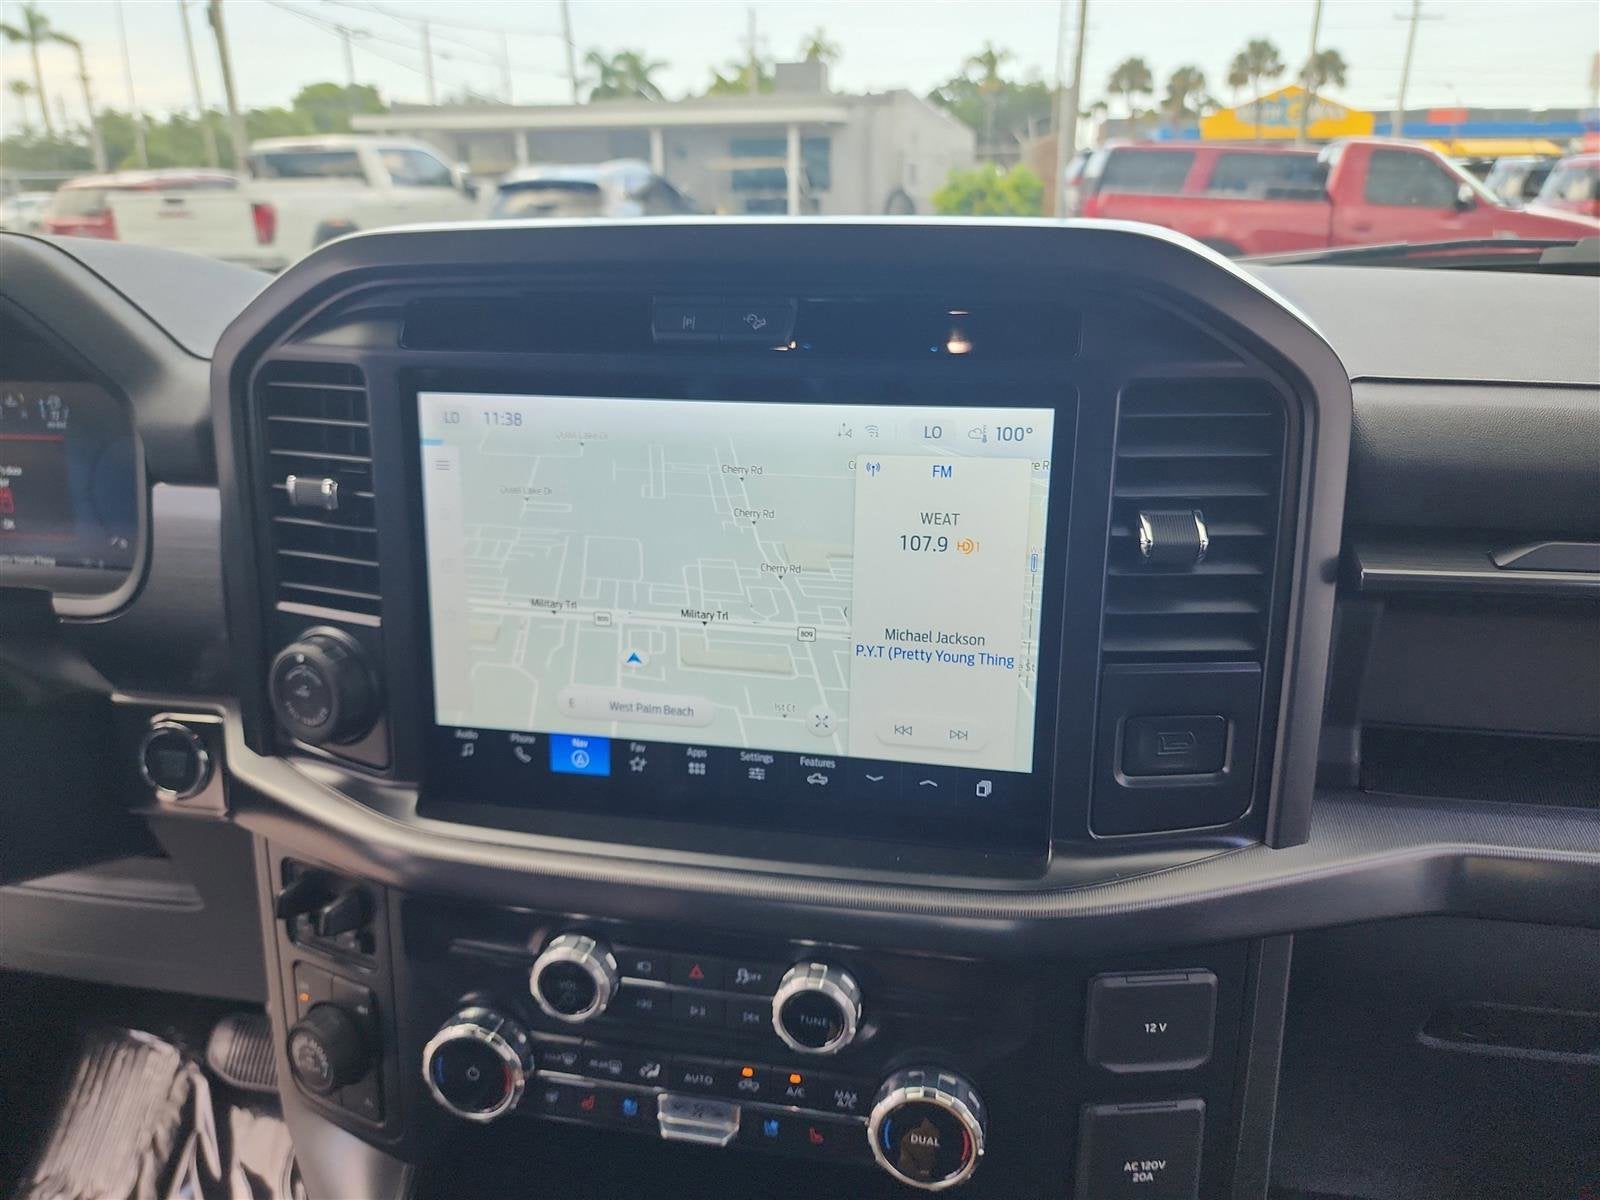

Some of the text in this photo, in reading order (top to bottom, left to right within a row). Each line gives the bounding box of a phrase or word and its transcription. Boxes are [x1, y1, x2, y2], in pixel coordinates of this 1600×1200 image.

[483, 411, 522, 427] 11:38
[924, 425, 943, 439] LO
[996, 426, 1034, 442] 100°
[721, 464, 763, 475] Cherry Rd
[932, 465, 953, 478] FM
[733, 508, 775, 519] Cherry Rd
[920, 512, 961, 526] WEAT
[900, 535, 948, 553] 107.9
[760, 562, 801, 574] Cherry Rd
[531, 599, 562, 610] Military
[681, 609, 729, 622] Military Trl
[885, 628, 986, 647] Michael Jackson
[855, 644, 886, 658] P.Y.T
[888, 646, 933, 663] (Pretty
[935, 650, 976, 667] Young
[978, 653, 1015, 670] Thing
[609, 700, 634, 713] West
[636, 702, 661, 714] Palm
[663, 704, 695, 717] Beach
[455, 729, 479, 740] Audio
[509, 733, 536, 745] Phone
[571, 738, 589, 749] Nav
[629, 742, 647, 753] Fav
[686, 747, 708, 759] Apps
[740, 751, 775, 764] Settings
[800, 756, 837, 769] Features
[800, 1014, 829, 1028] TUNE
[1144, 1022, 1168, 1033] 12 V
[684, 1072, 714, 1086] AUTO
[786, 1085, 805, 1098] A/C
[910, 1133, 941, 1148] DUAL
[1123, 1160, 1167, 1172] AC 120V
[1132, 1171, 1154, 1183] 20A
